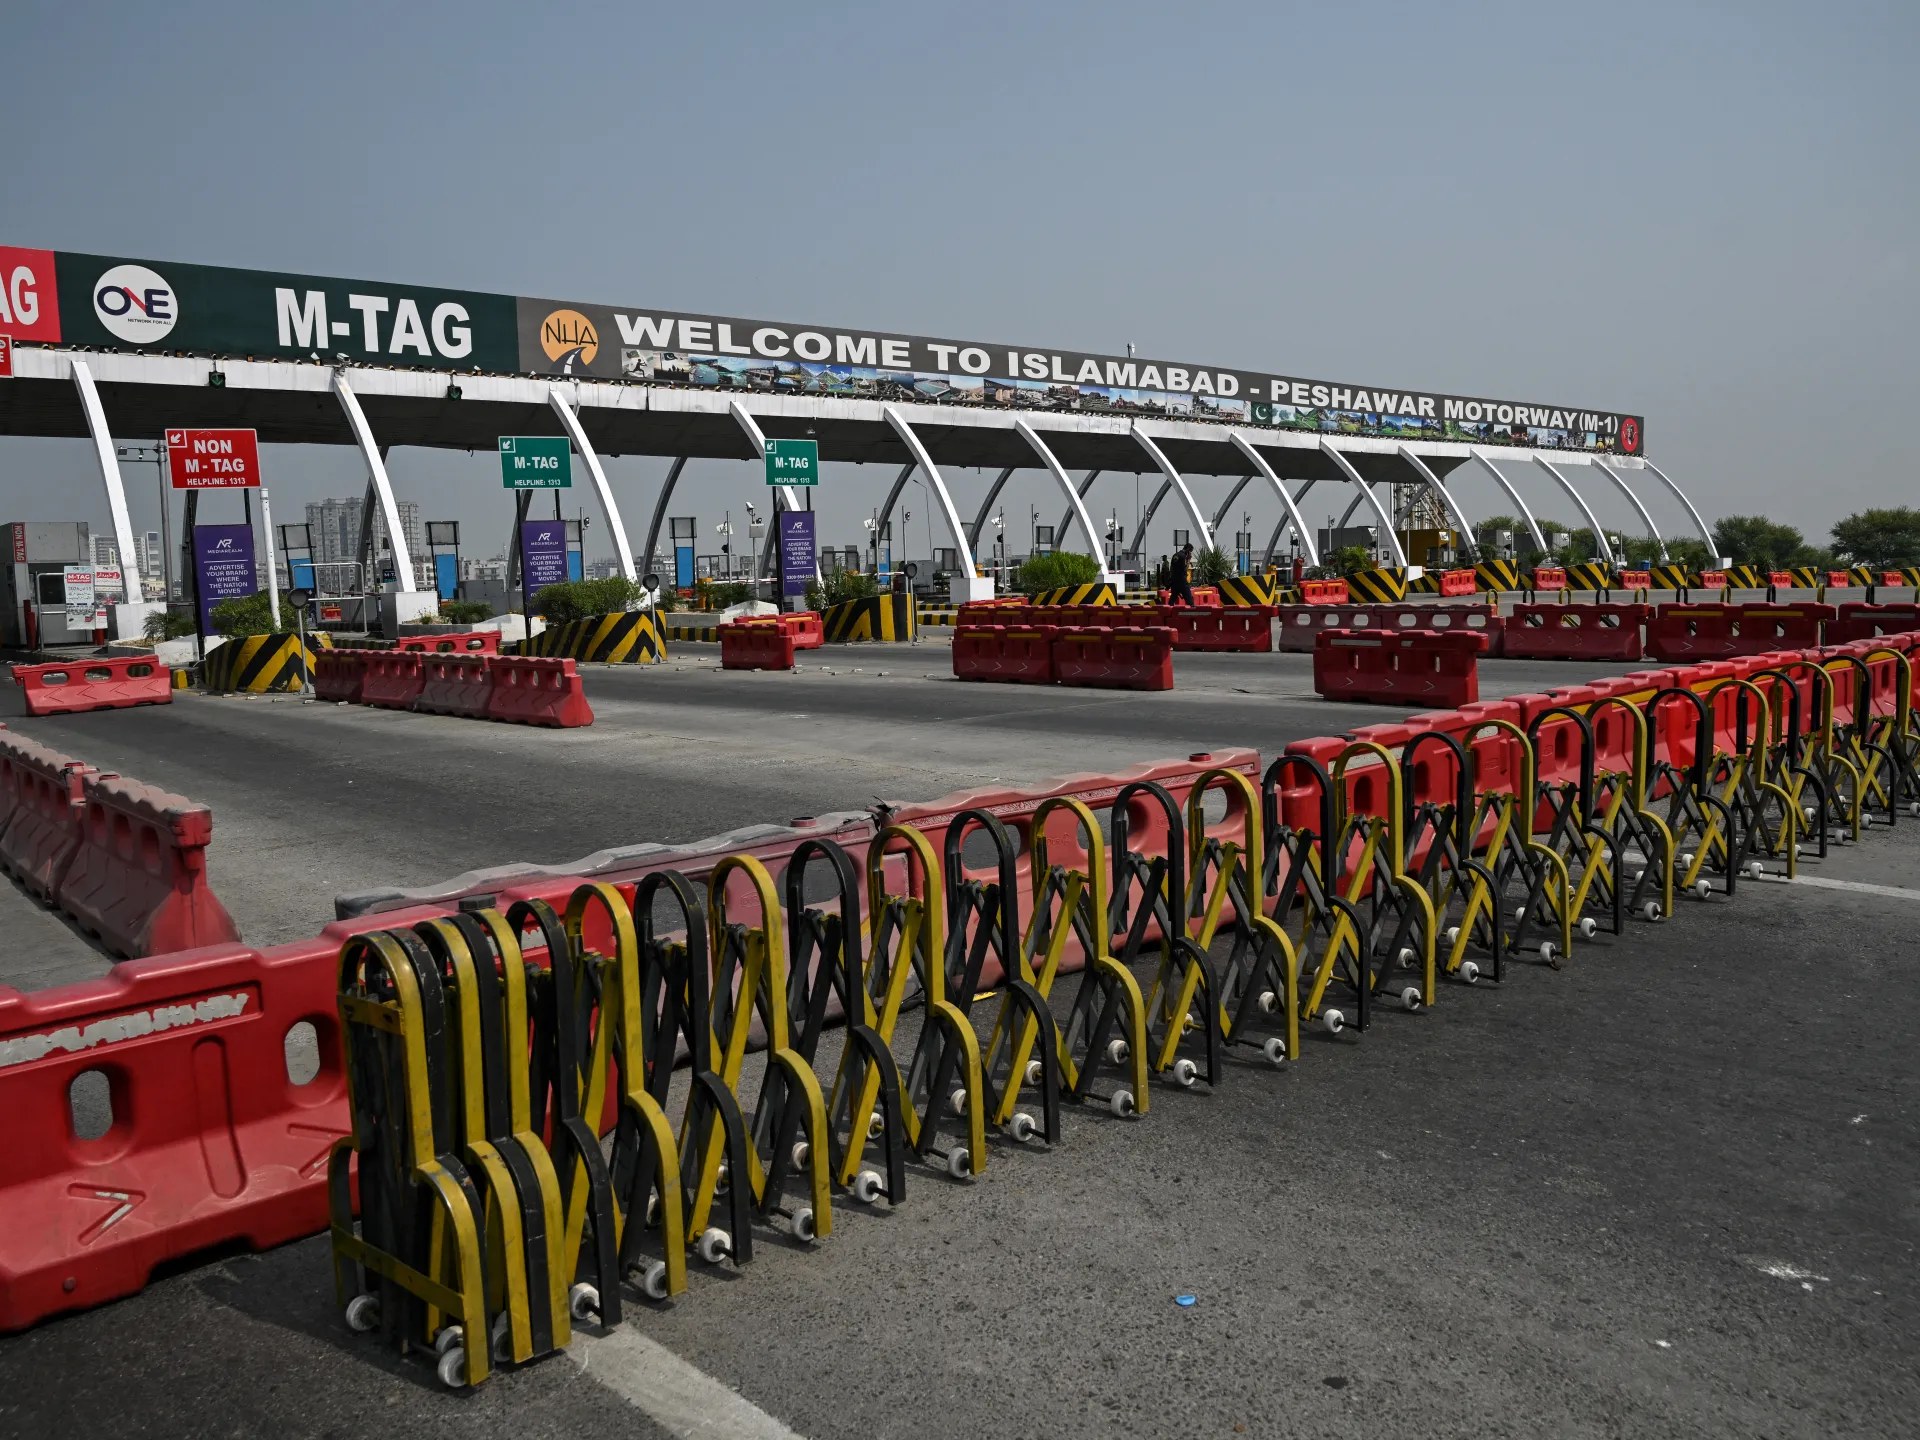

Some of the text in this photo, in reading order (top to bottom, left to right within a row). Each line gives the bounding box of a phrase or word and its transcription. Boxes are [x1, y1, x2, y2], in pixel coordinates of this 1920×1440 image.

[97, 285, 172, 319] ONE
[275, 287, 472, 359] M-TAG
[545, 318, 597, 346] NHA
[613, 314, 912, 368] WELCOME
[927, 343, 991, 375] TO
[1008, 352, 1239, 397] ISLAMABAD
[1270, 379, 1436, 417] PESHAWAR
[193, 439, 233, 454] NON
[514, 456, 559, 469] M-TAG
[775, 457, 809, 469] M-TAG
[187, 477, 246, 486] HELPLINE: 1313
[547, 478, 561, 486] 1313
[14, 525, 25, 561] NON M-TAG
[208, 563, 245, 571] ADVERTISE
